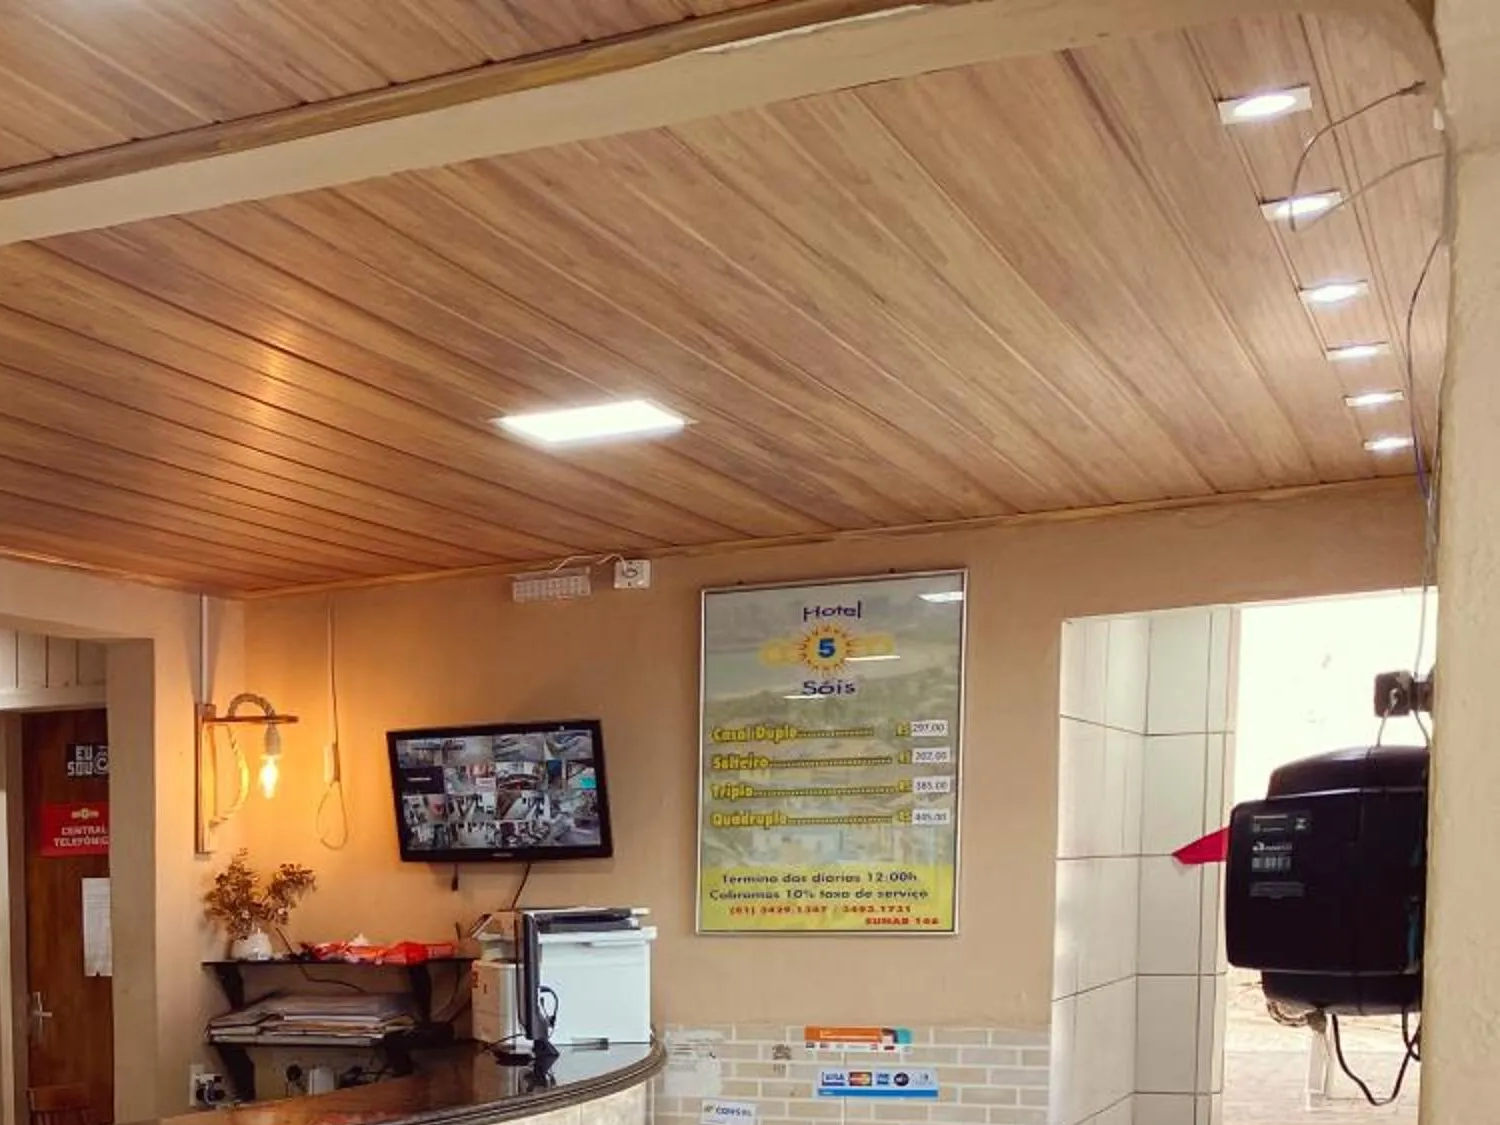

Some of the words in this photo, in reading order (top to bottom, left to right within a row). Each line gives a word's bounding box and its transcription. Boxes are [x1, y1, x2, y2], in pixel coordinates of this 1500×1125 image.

[803, 600, 862, 622] Hotel
[818, 637, 836, 658] 5
[802, 679, 856, 695] Sóis
[75, 744, 93, 761] EU
[67, 760, 94, 777] SOU
[61, 824, 106, 837] CENTRAL
[53, 836, 109, 848] TELEFÔNIC
[855, 888, 873, 898] de
